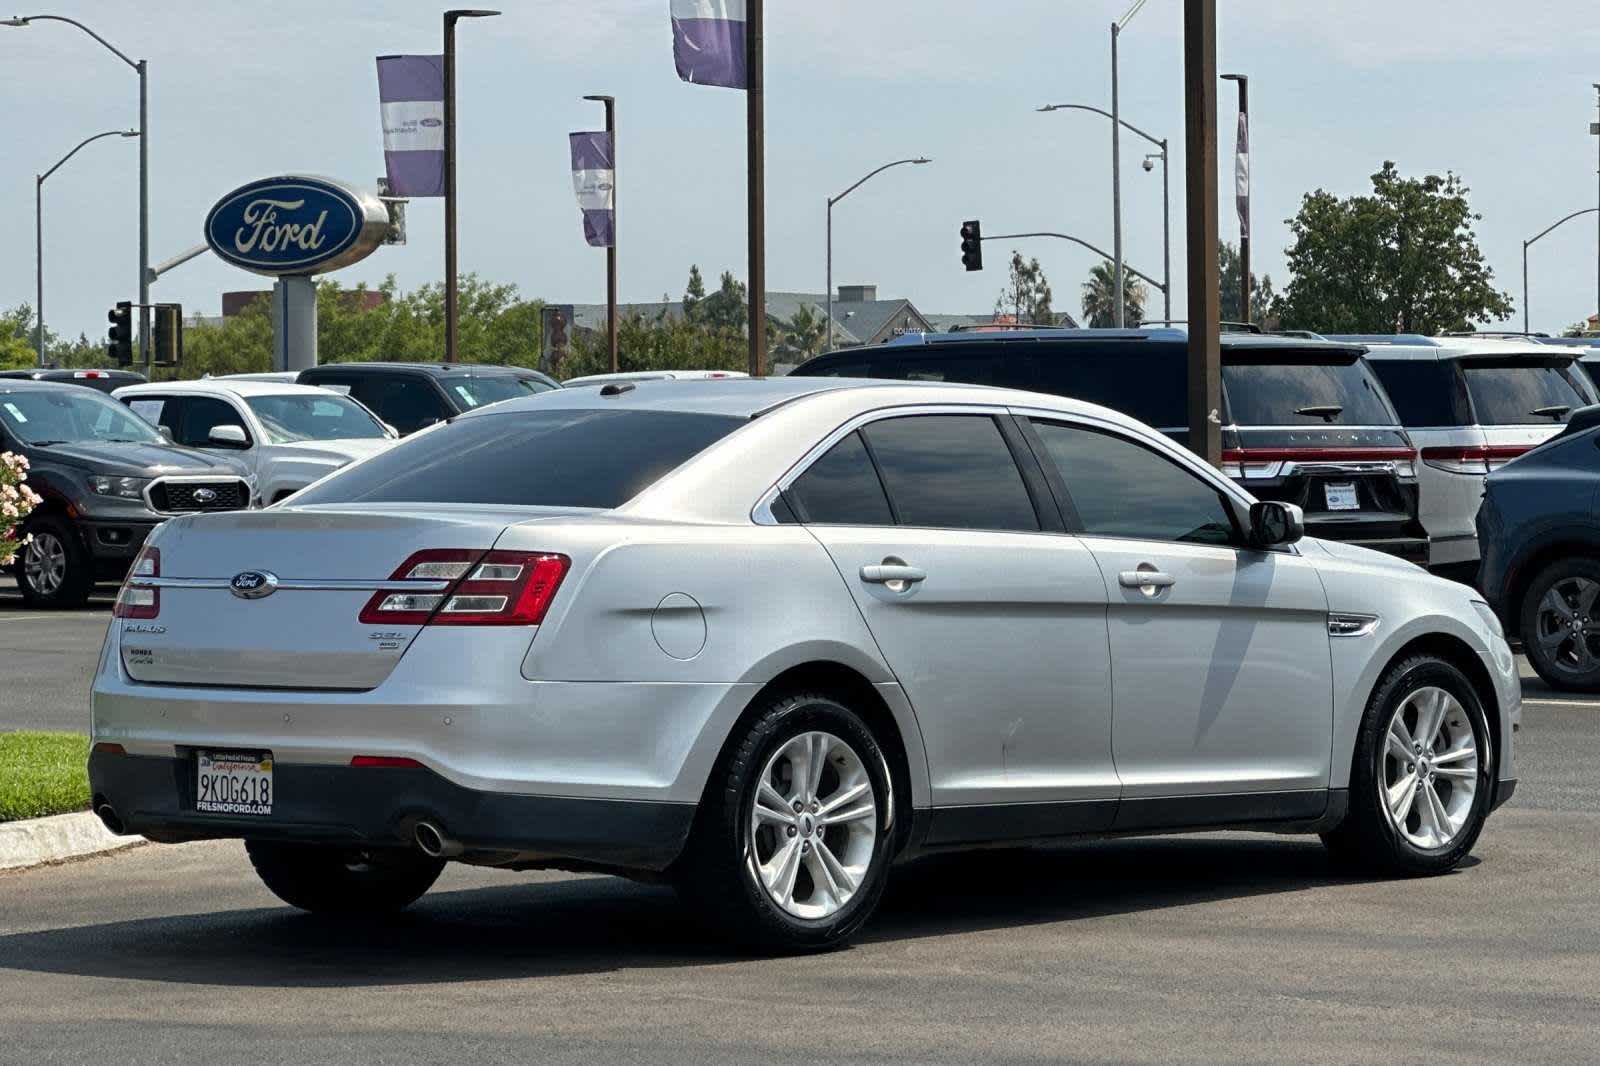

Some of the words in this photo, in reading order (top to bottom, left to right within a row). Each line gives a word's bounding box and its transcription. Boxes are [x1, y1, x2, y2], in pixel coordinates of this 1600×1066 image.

[235, 199, 329, 253] Ford
[235, 574, 260, 588] Ford
[368, 632, 407, 640] SEL
[130, 648, 153, 656] HONDA
[212, 761, 260, 775] California
[196, 801, 272, 815] FRESNOFORD.COM
